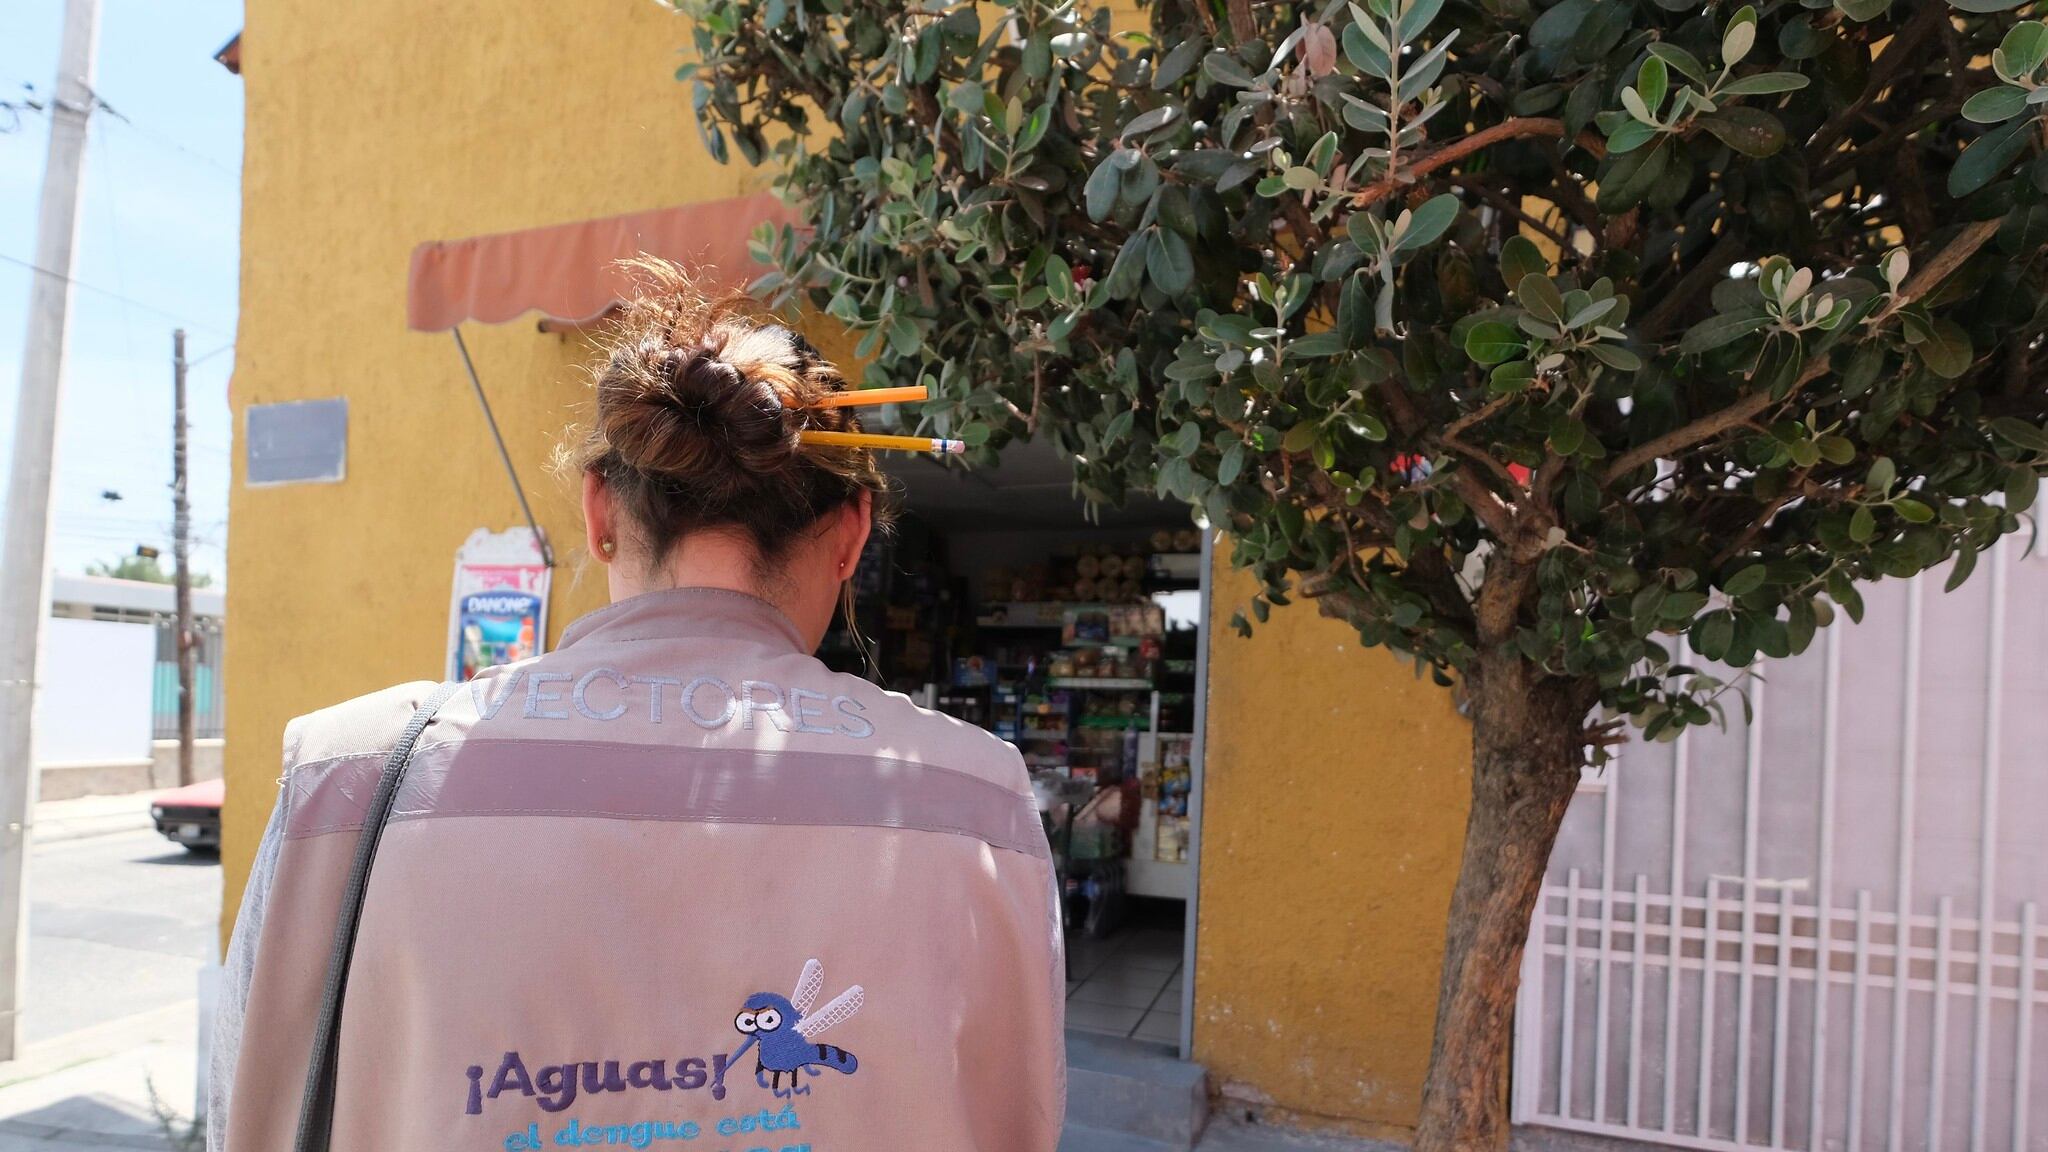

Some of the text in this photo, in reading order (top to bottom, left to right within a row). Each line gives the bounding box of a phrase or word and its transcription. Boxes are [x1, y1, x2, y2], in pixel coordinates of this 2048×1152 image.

[471, 668, 876, 739] VECTORES
[465, 1051, 728, 1115] ¡Aguas!
[503, 1103, 801, 1152] el dengue está
